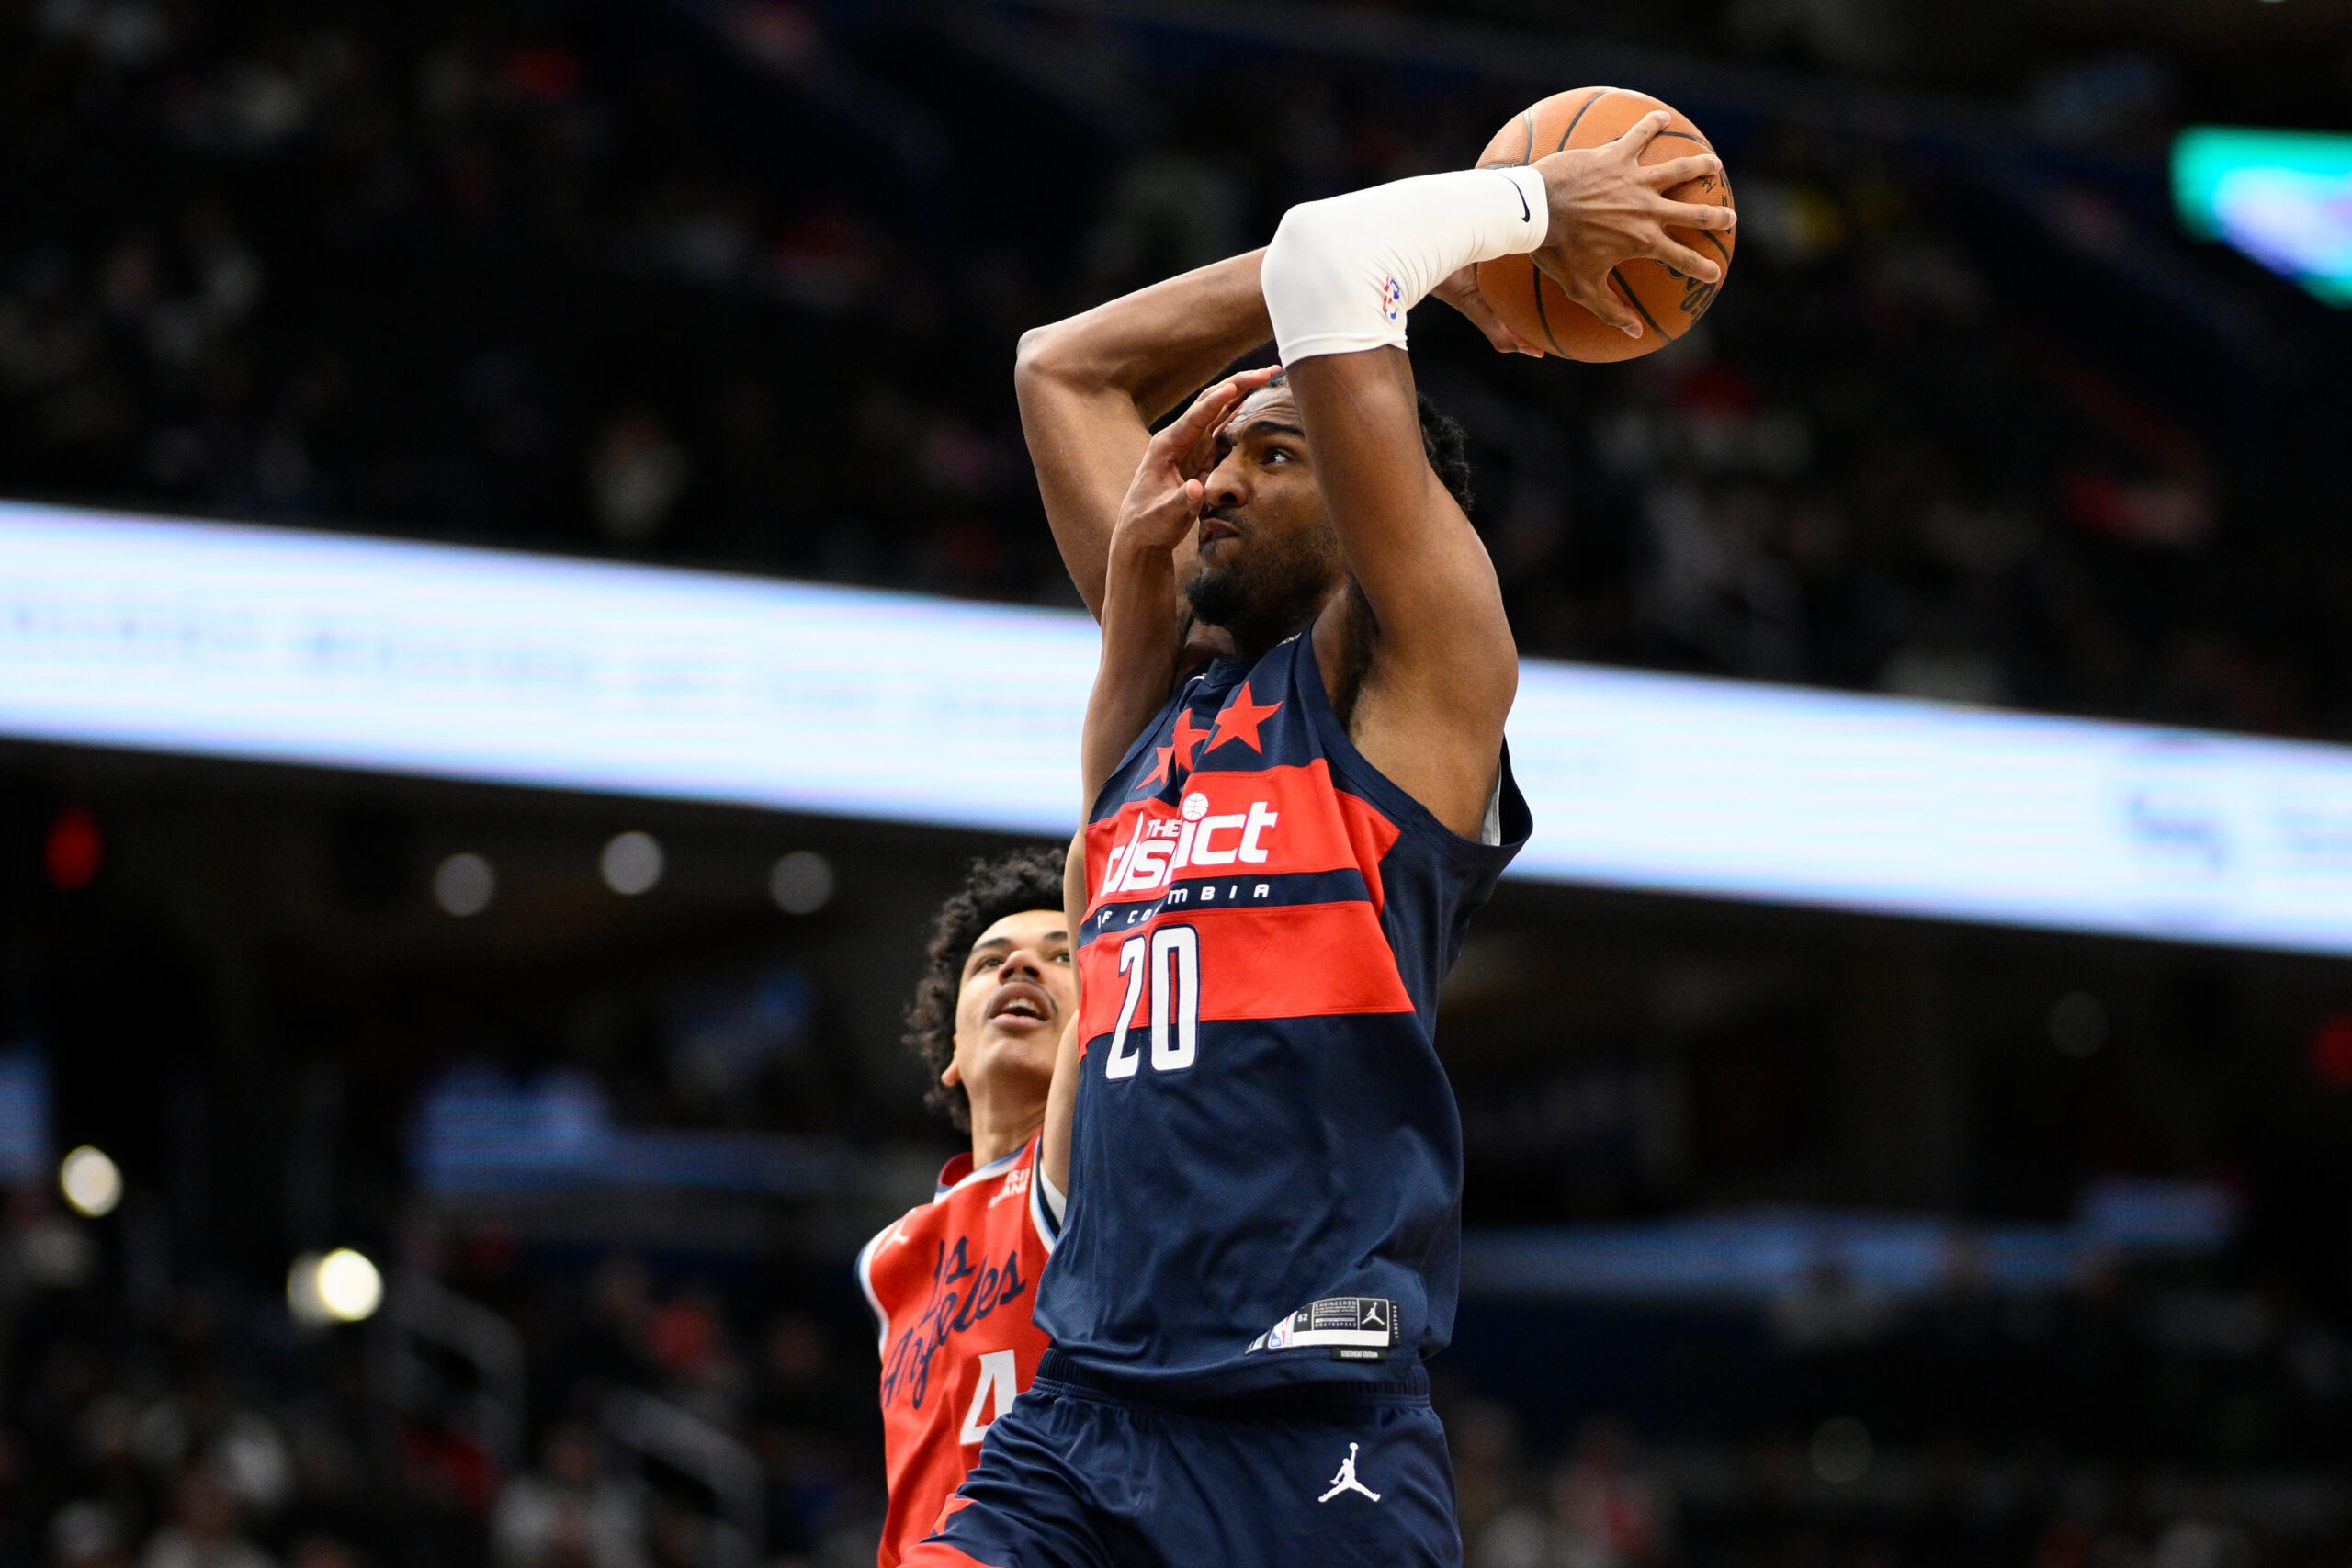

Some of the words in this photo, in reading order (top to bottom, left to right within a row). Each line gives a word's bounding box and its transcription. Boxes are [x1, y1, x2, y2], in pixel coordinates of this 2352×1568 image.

[1146, 818, 1182, 838] THE
[1104, 926, 1200, 1080] 20
[960, 1349, 1018, 1446] 4
